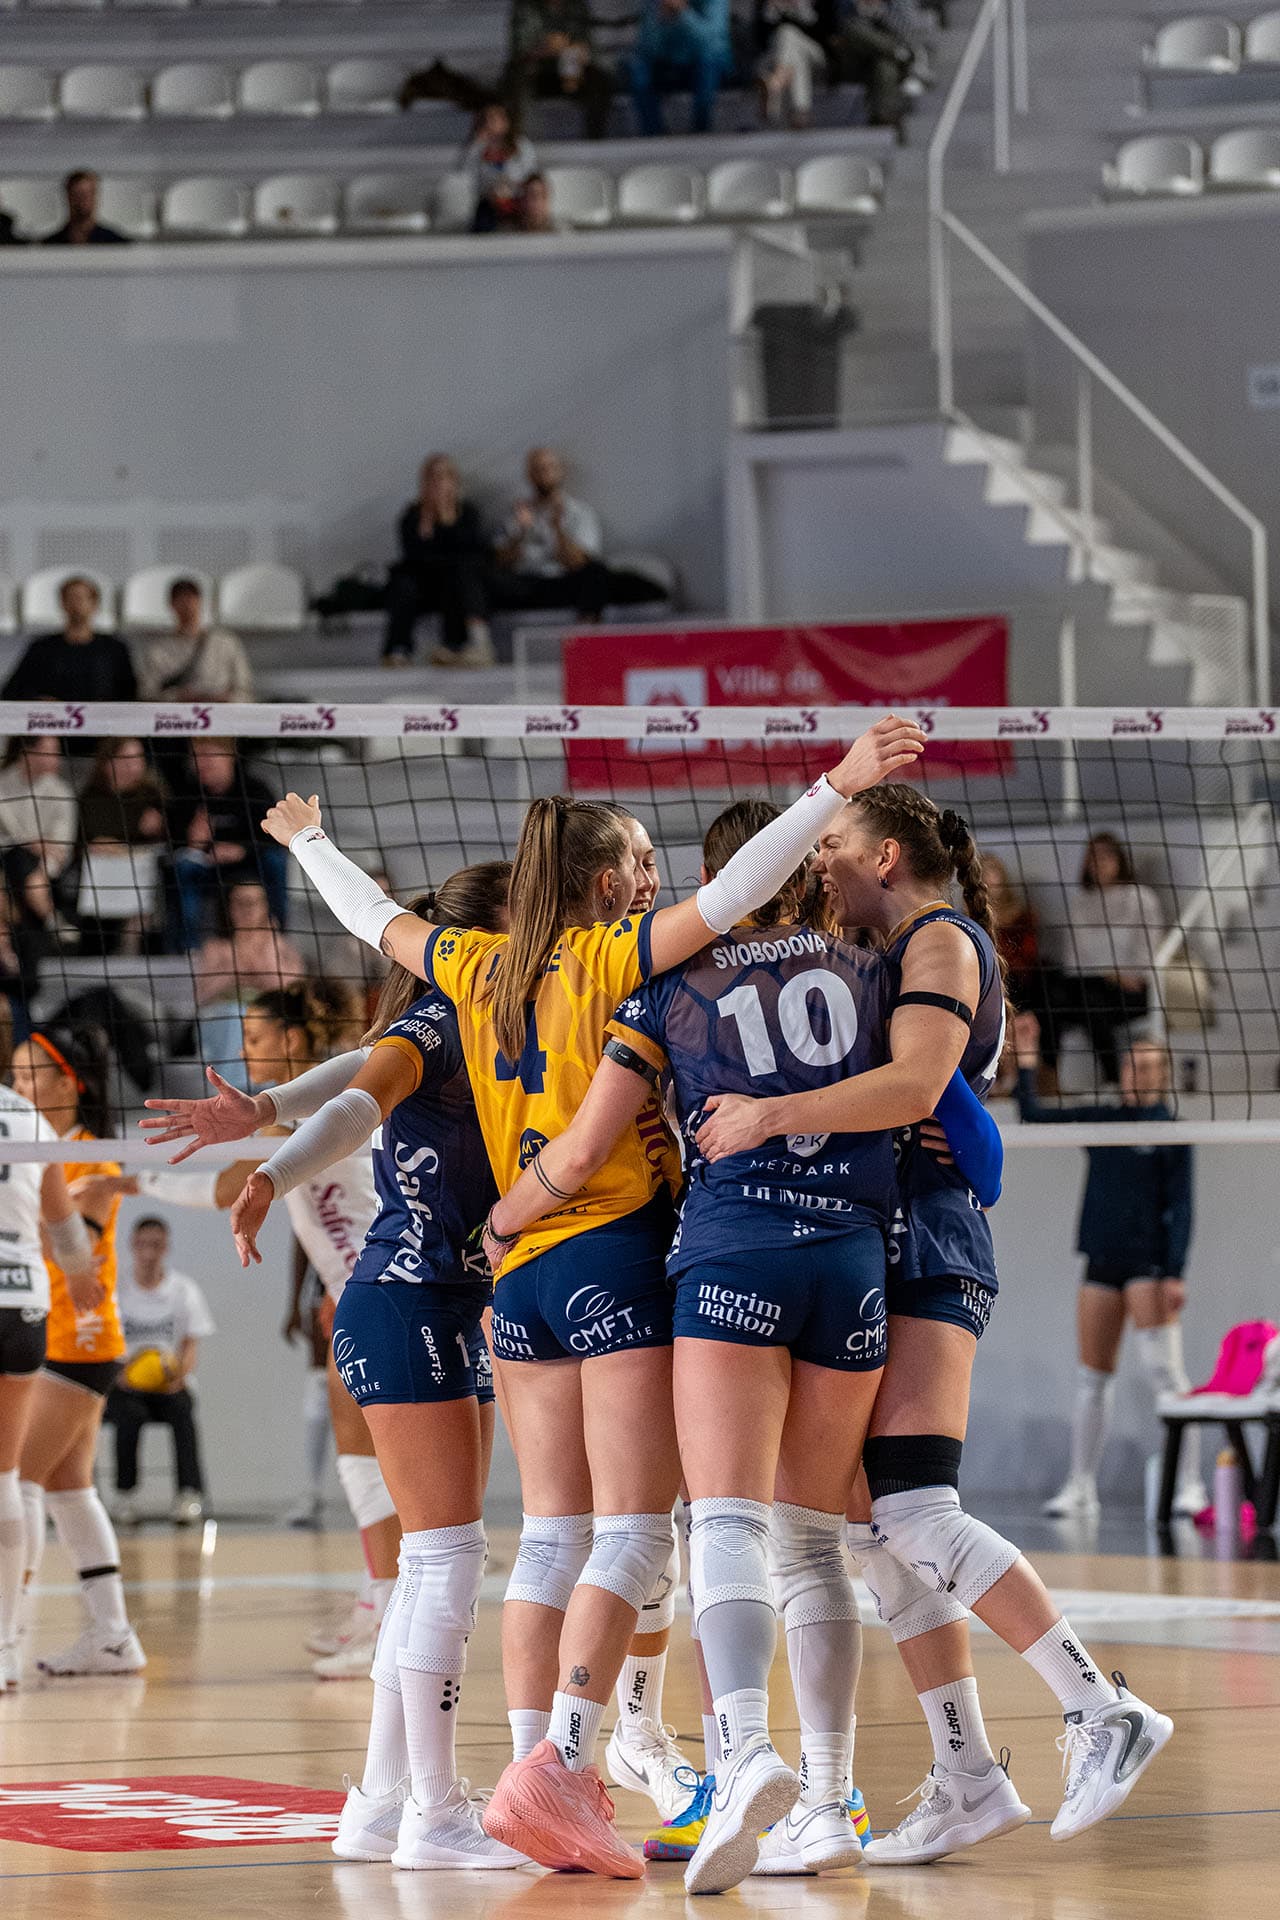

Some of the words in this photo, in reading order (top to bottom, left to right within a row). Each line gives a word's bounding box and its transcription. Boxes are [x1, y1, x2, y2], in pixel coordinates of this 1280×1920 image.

[712, 934, 828, 969] SVOBODOVA
[401, 1024, 434, 1051] SPORT
[407, 1020, 442, 1047] INTER
[716, 968, 858, 1077] 10
[569, 1306, 635, 1351] CMFT
[698, 1300, 776, 1337] nation
[421, 1325, 442, 1371] CRAFT
[846, 1325, 888, 1351] CMF
[339, 1358, 367, 1386] MFT
[1062, 1639, 1089, 1670] CRAFT
[632, 1670, 647, 1702] CRAFT
[569, 1712, 581, 1748] CRAFT
[719, 1713, 730, 1744] CRAFT
[943, 1701, 961, 1737] CRAFT
